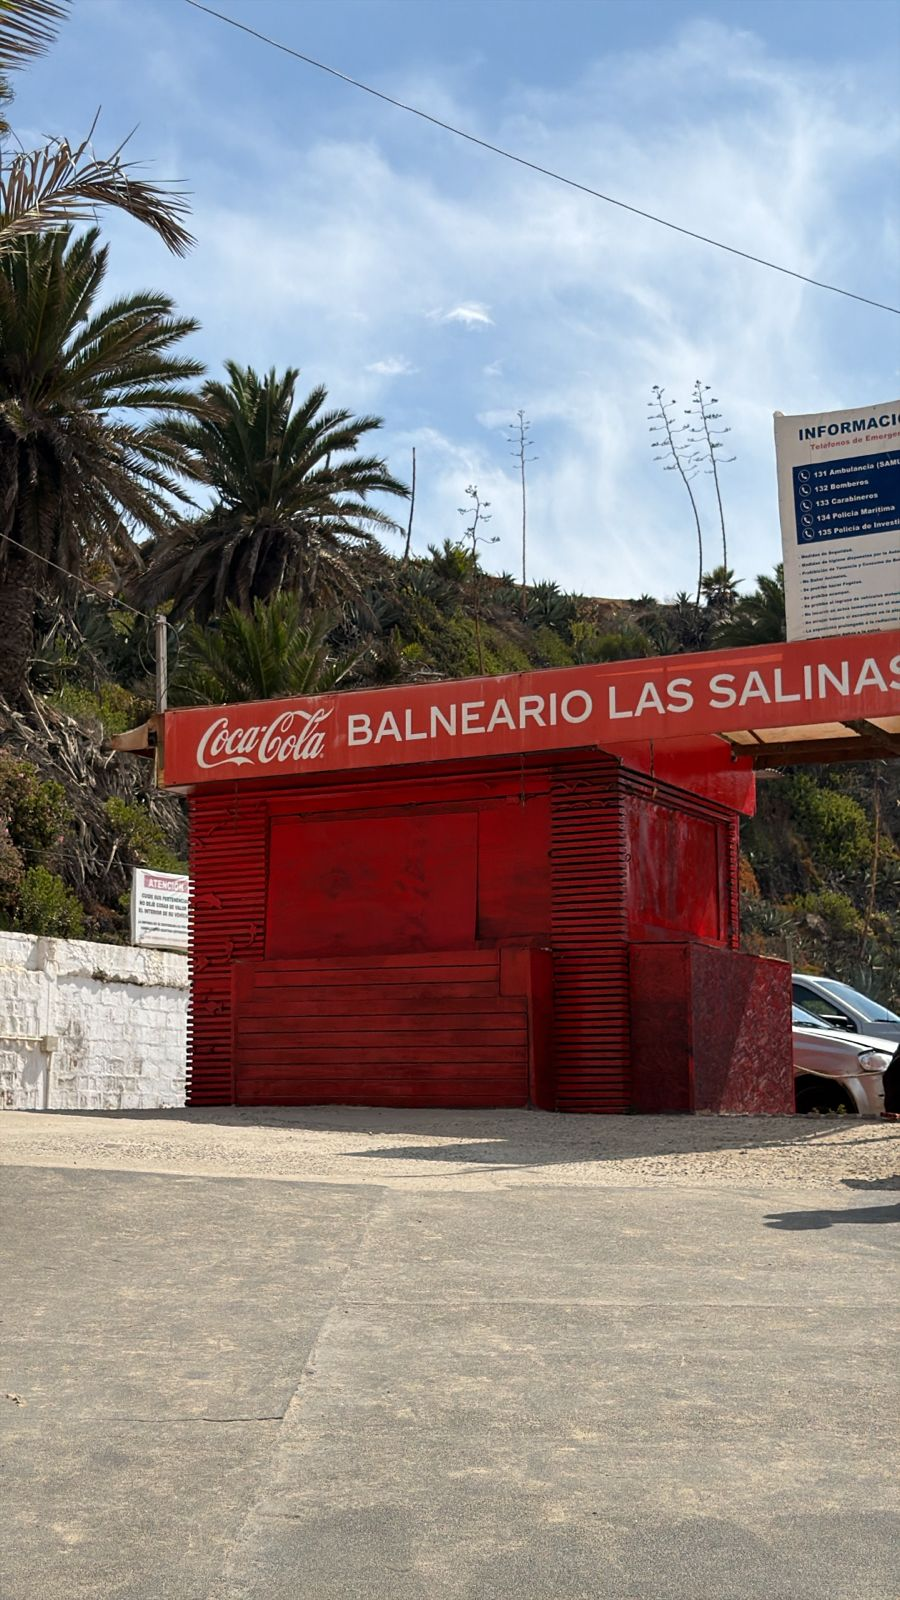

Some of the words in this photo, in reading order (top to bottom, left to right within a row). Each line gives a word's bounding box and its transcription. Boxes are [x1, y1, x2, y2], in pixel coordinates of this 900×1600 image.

[799, 413, 900, 440] INFORMACI
[814, 469, 827, 478] 131
[829, 463, 874, 476] Ambulancia
[814, 484, 828, 493] 132
[830, 479, 869, 490] Bomberos
[815, 498, 830, 507] 133
[831, 492, 878, 504] Carabineros
[816, 512, 830, 522] 134
[818, 527, 832, 536] 135
[861, 522, 872, 530] de
[347, 689, 593, 746] BALNEARIO
[608, 677, 694, 720] LAS
[196, 707, 335, 769] Coca-Cola
